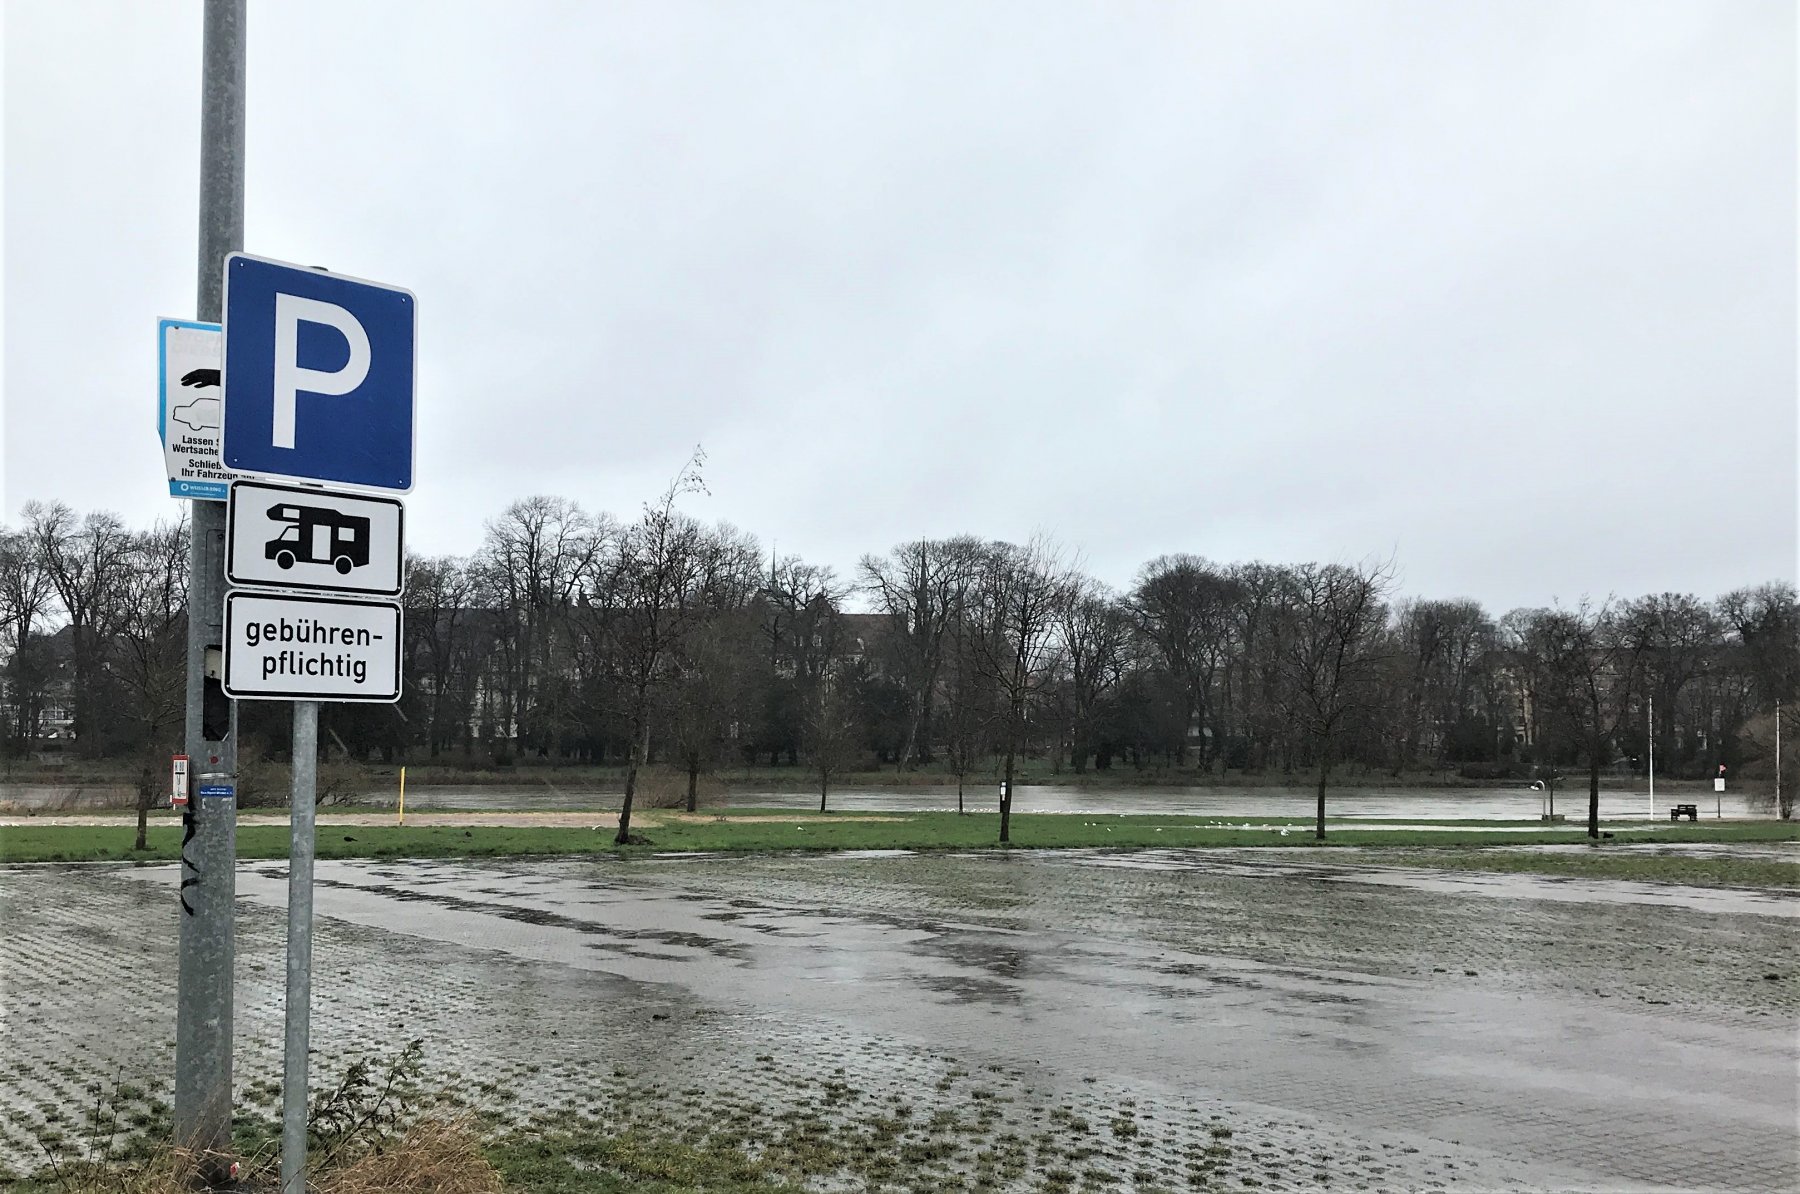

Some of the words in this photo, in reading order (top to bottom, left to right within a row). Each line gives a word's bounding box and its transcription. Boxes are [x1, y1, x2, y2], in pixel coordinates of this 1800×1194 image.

[272, 291, 371, 450] P
[182, 435, 213, 446] Lassen
[172, 443, 219, 456] Wertsache
[189, 459, 222, 470] Schließ
[181, 468, 194, 477] Ihr
[246, 617, 383, 647] gebühren-
[262, 650, 367, 684] pflichtig
